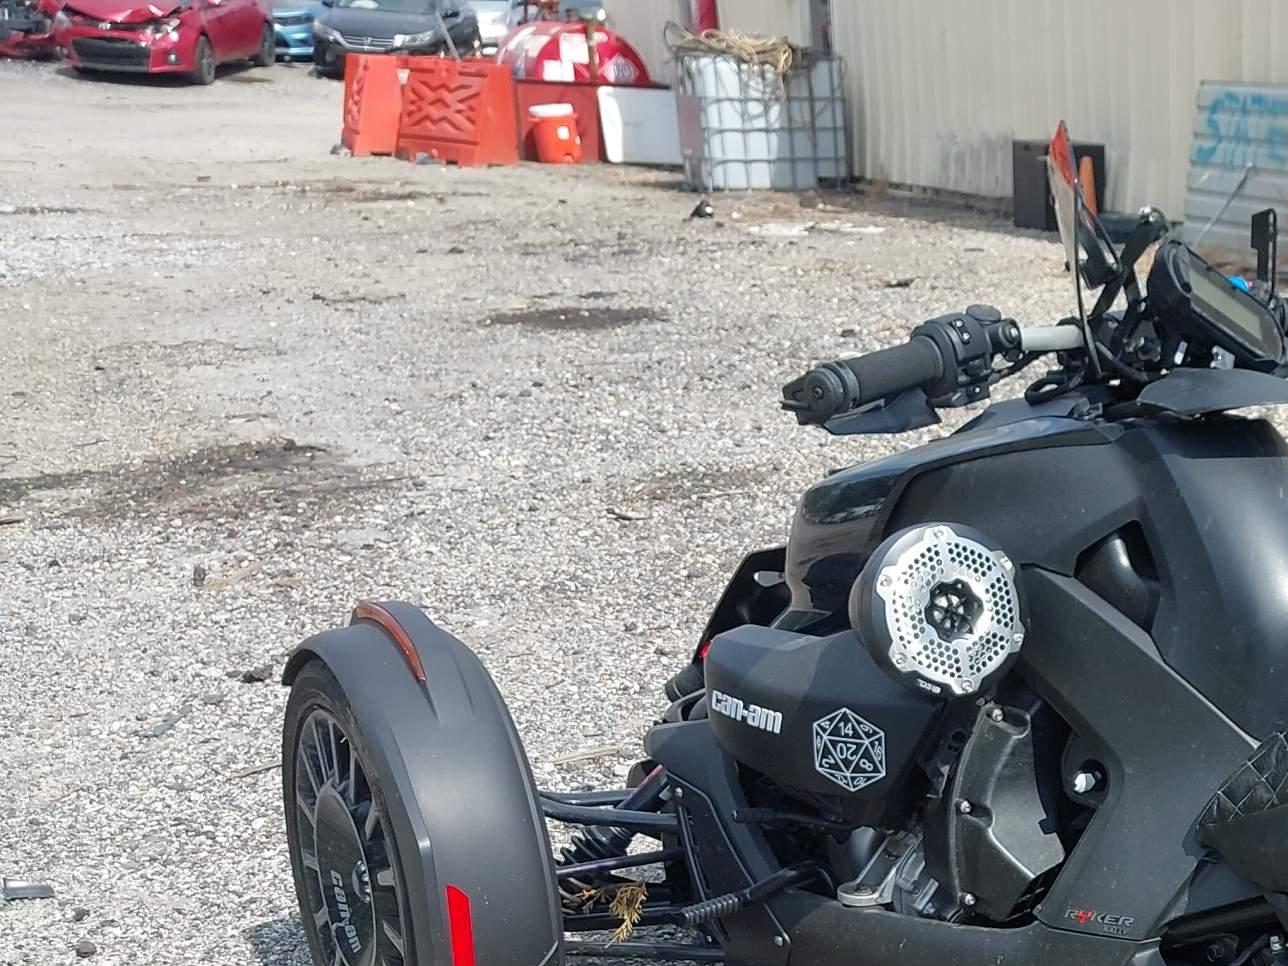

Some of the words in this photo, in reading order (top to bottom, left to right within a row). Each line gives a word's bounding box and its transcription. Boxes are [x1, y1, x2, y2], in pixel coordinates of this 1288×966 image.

[711, 689, 783, 735] can-am
[838, 721, 853, 737] 14
[837, 743, 857, 760] 20
[860, 758, 873, 771] 8
